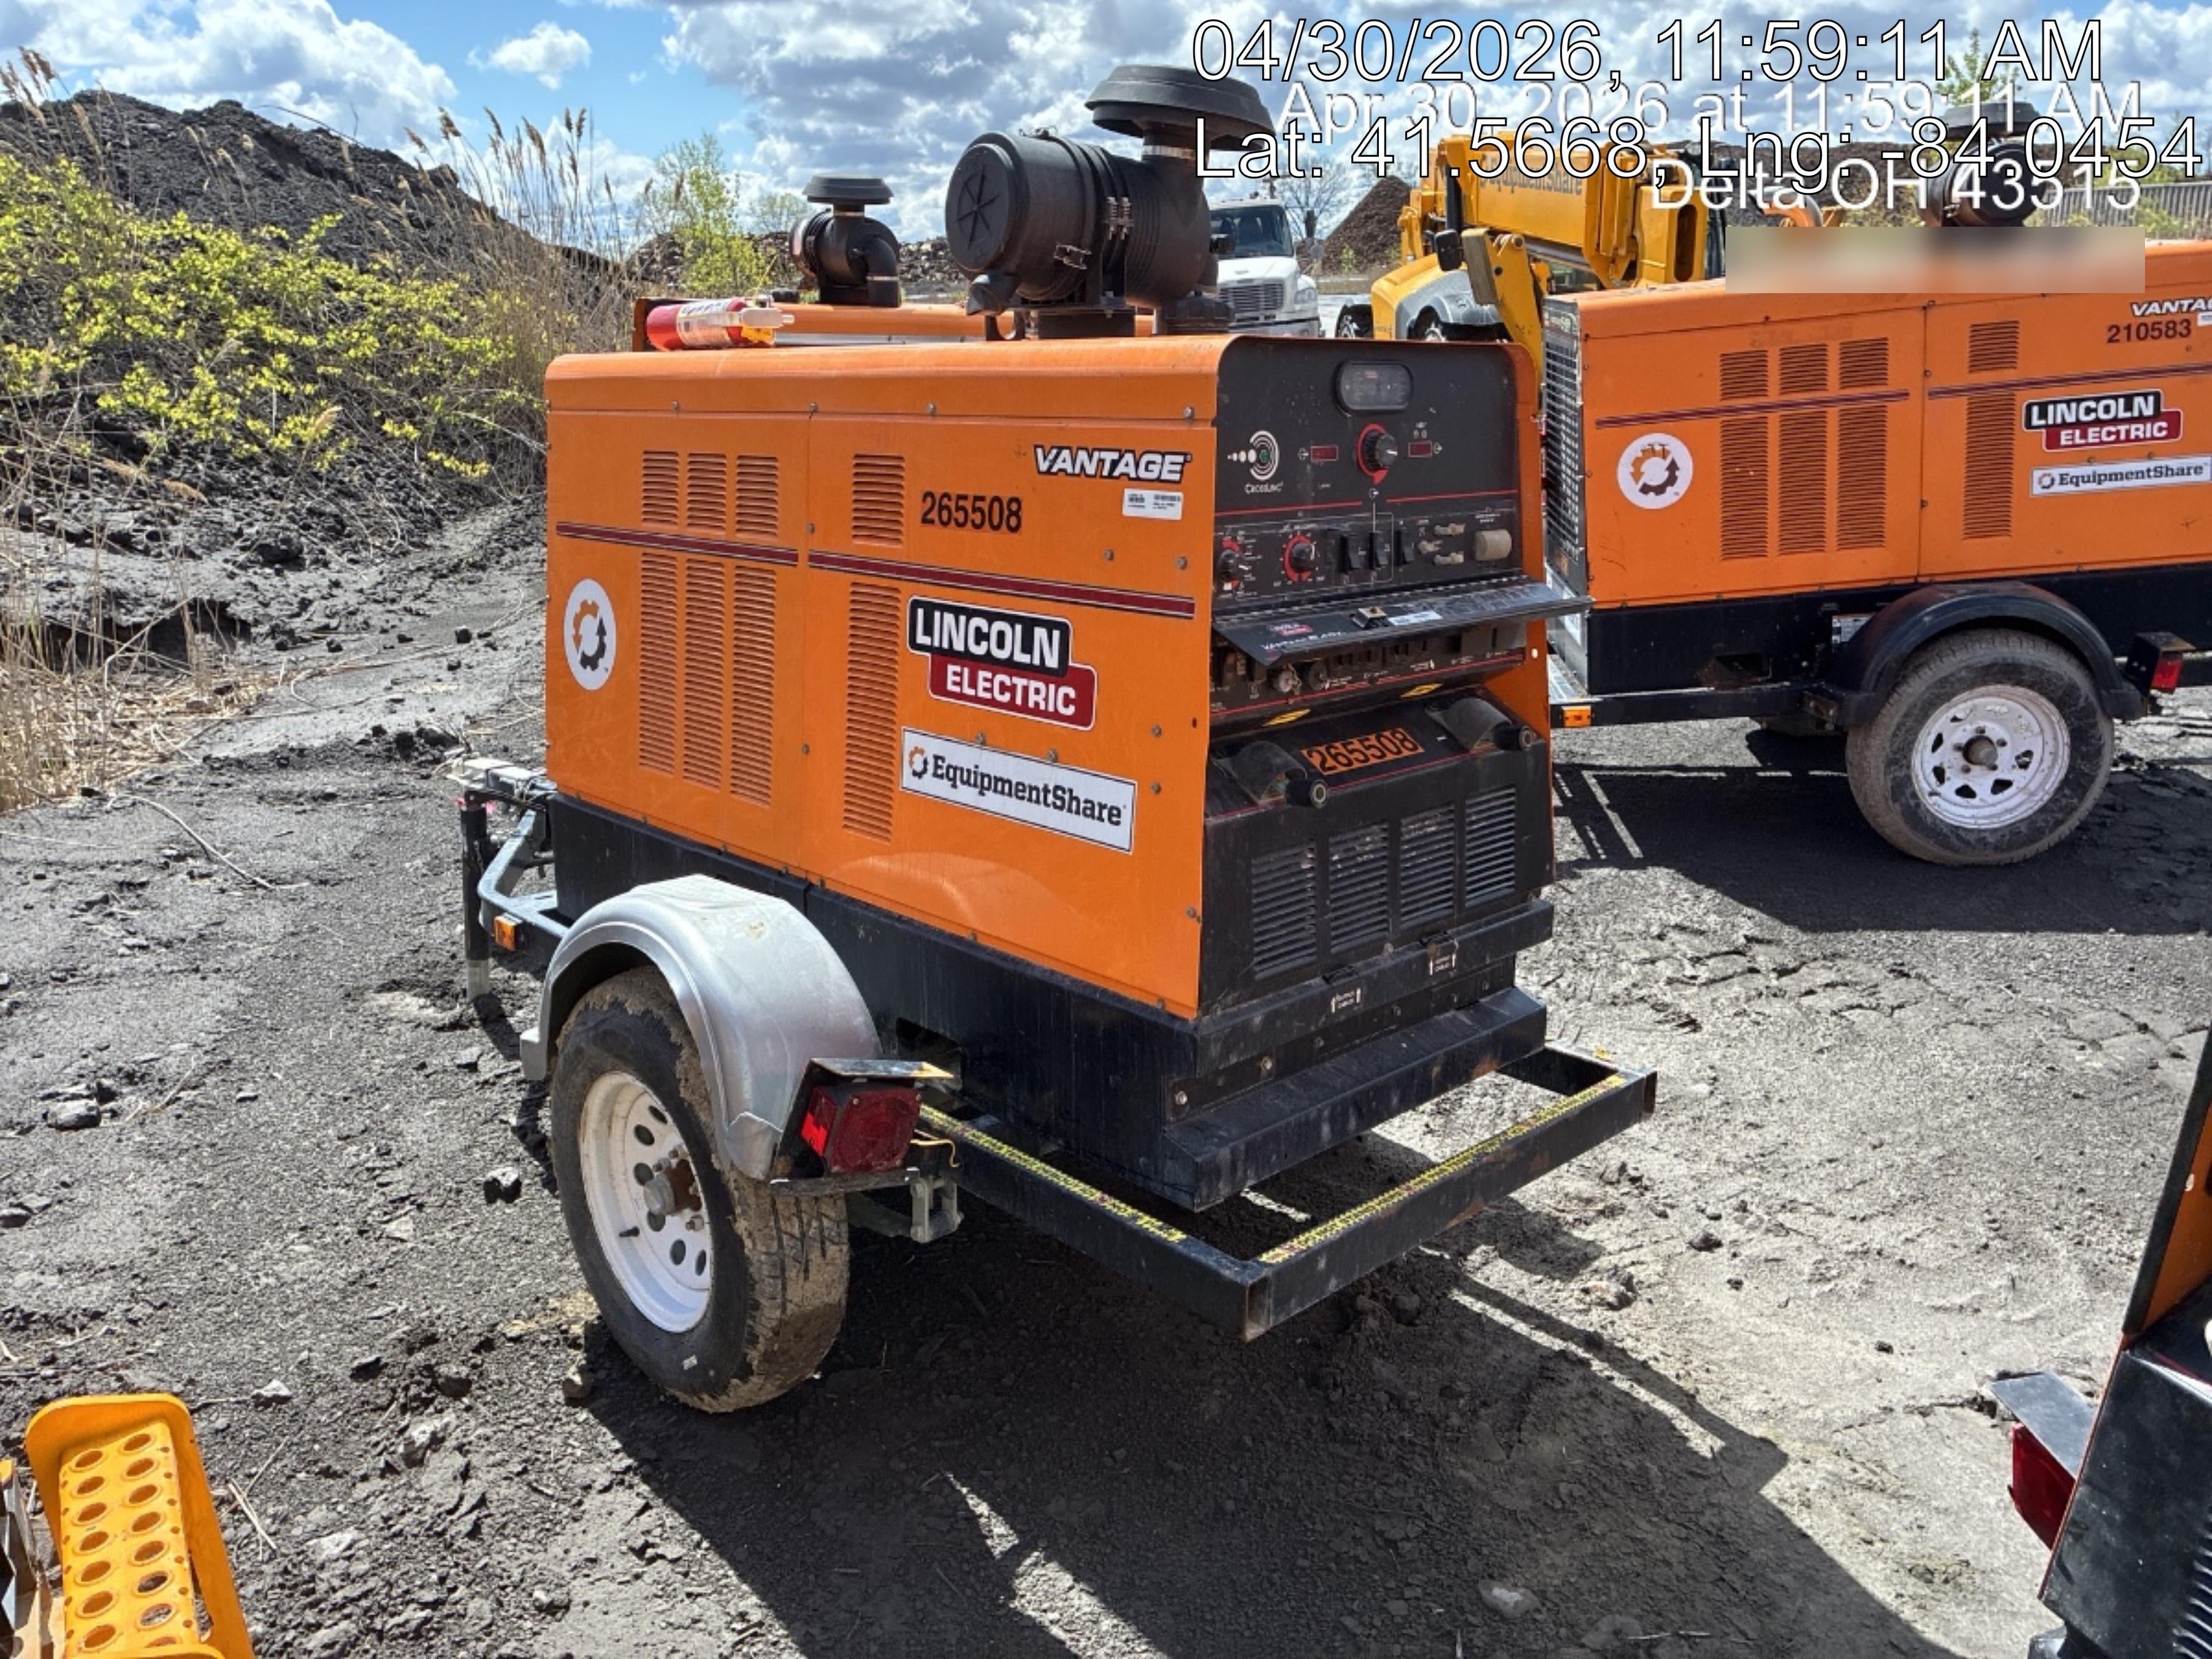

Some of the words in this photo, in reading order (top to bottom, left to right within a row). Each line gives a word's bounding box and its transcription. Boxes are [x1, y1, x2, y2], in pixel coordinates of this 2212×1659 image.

[2132, 297, 2212, 316] VANTA
[2106, 318, 2192, 343] 210583
[2030, 395, 2154, 427] LINCOLN
[2060, 422, 2168, 447] ELECTRIC
[1035, 446, 1185, 482] VANTAGE
[2058, 463, 2203, 487] EquipmentShare
[921, 490, 1022, 533] 265508
[916, 607, 1061, 669] LINCOLN
[946, 662, 1077, 716] ELECTRIC
[1306, 728, 1419, 772] 265508
[932, 754, 1122, 828] EquipmentShare
